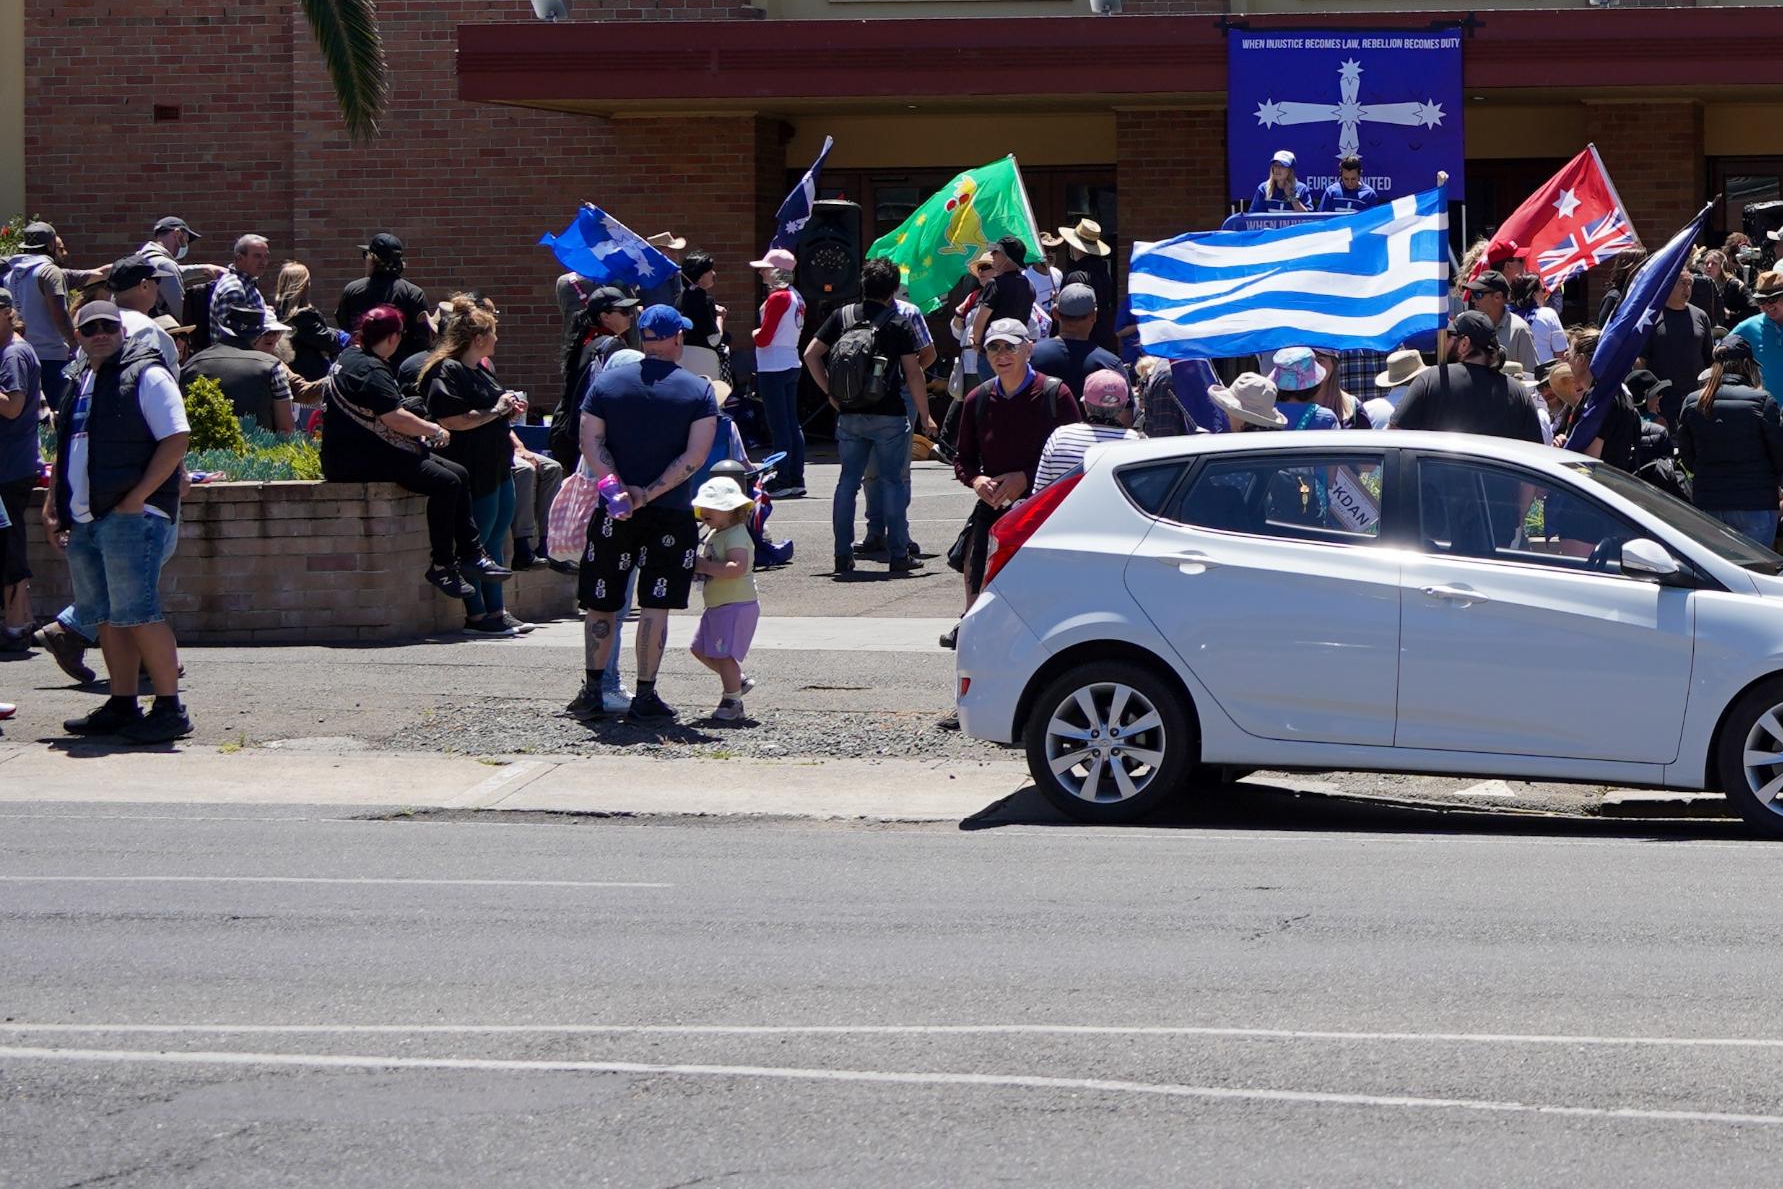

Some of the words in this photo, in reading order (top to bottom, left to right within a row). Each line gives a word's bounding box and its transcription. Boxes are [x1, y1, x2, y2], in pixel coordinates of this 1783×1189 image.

[1242, 39, 1265, 49] WHEN
[1266, 39, 1304, 49] INJUSTICE
[1305, 39, 1341, 49] BECOMES
[1342, 39, 1360, 50] LAW,
[1362, 39, 1402, 49] REBELLION
[1404, 38, 1439, 49] BECOMES
[1440, 37, 1461, 48] DUTY
